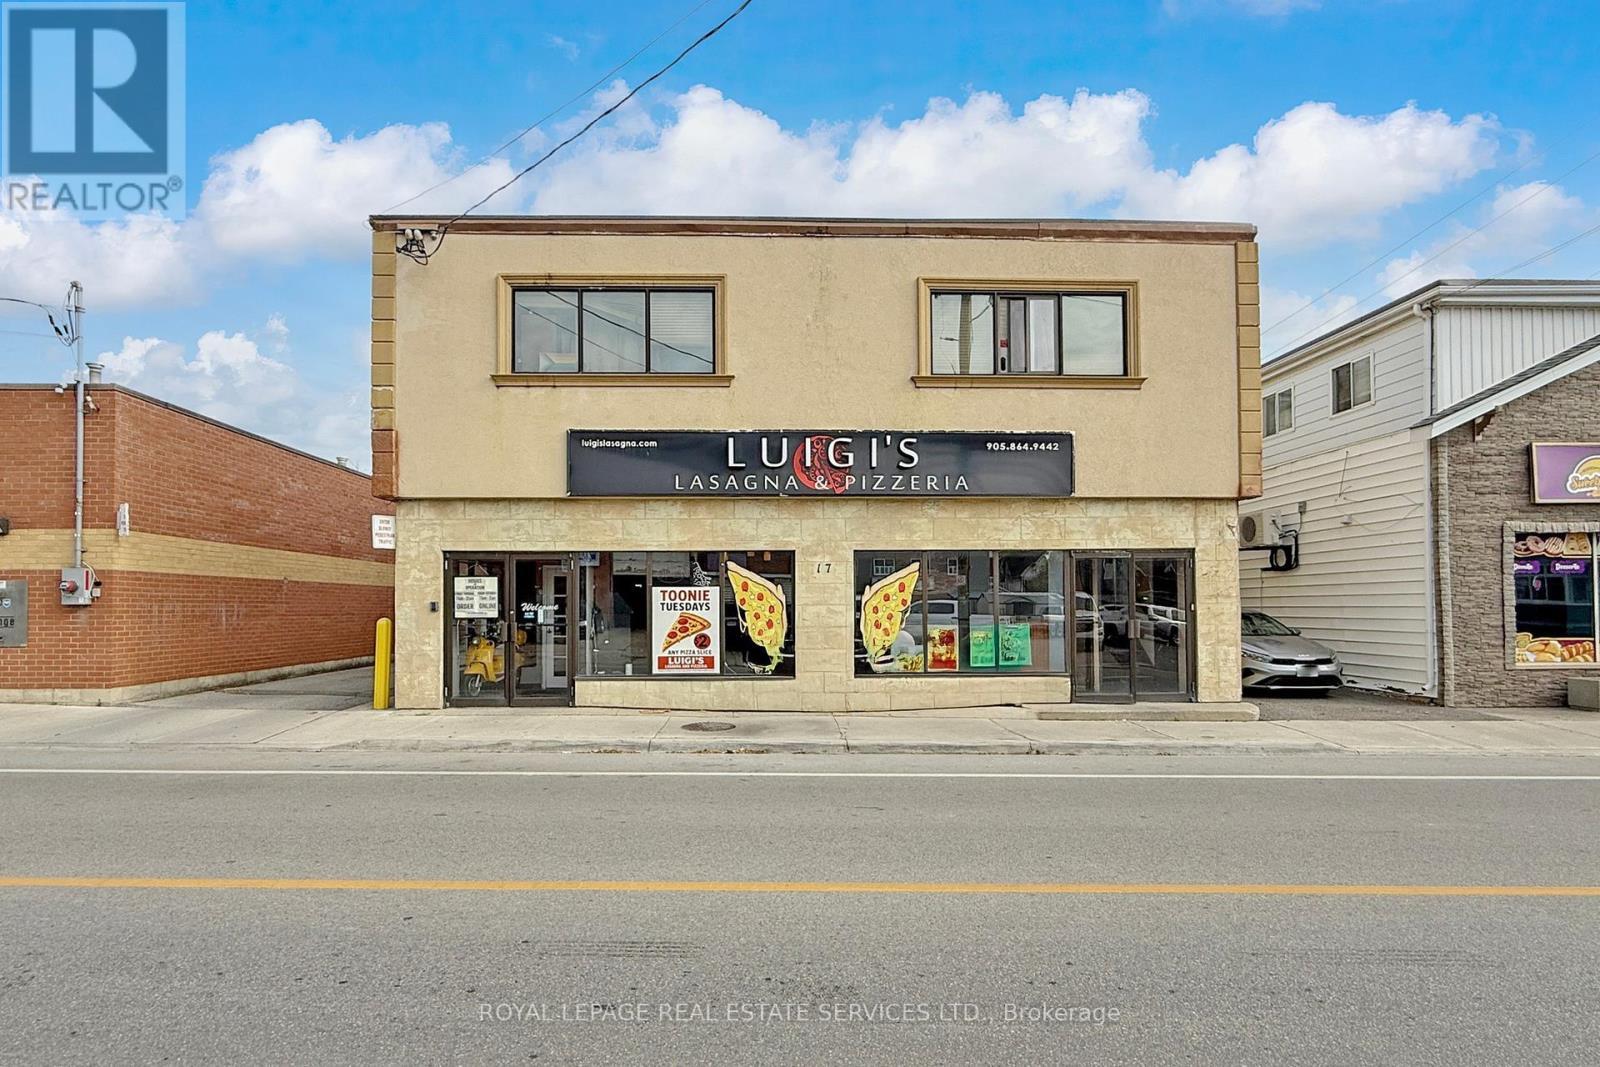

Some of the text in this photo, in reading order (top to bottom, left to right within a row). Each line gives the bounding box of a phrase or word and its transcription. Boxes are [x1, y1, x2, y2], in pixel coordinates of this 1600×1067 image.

[581, 439, 658, 449] luigislasagna.com
[986, 442, 1060, 451] 905.864.9442
[727, 436, 920, 469] LUIGI'S
[674, 474, 969, 490] LASAGNA & PIZZERIA
[817, 563, 832, 573] 17
[660, 590, 710, 601] TOONIE
[521, 602, 559, 611] Welcome
[660, 602, 710, 611] TUESDAYS
[668, 656, 705, 665] LUIGI'S
